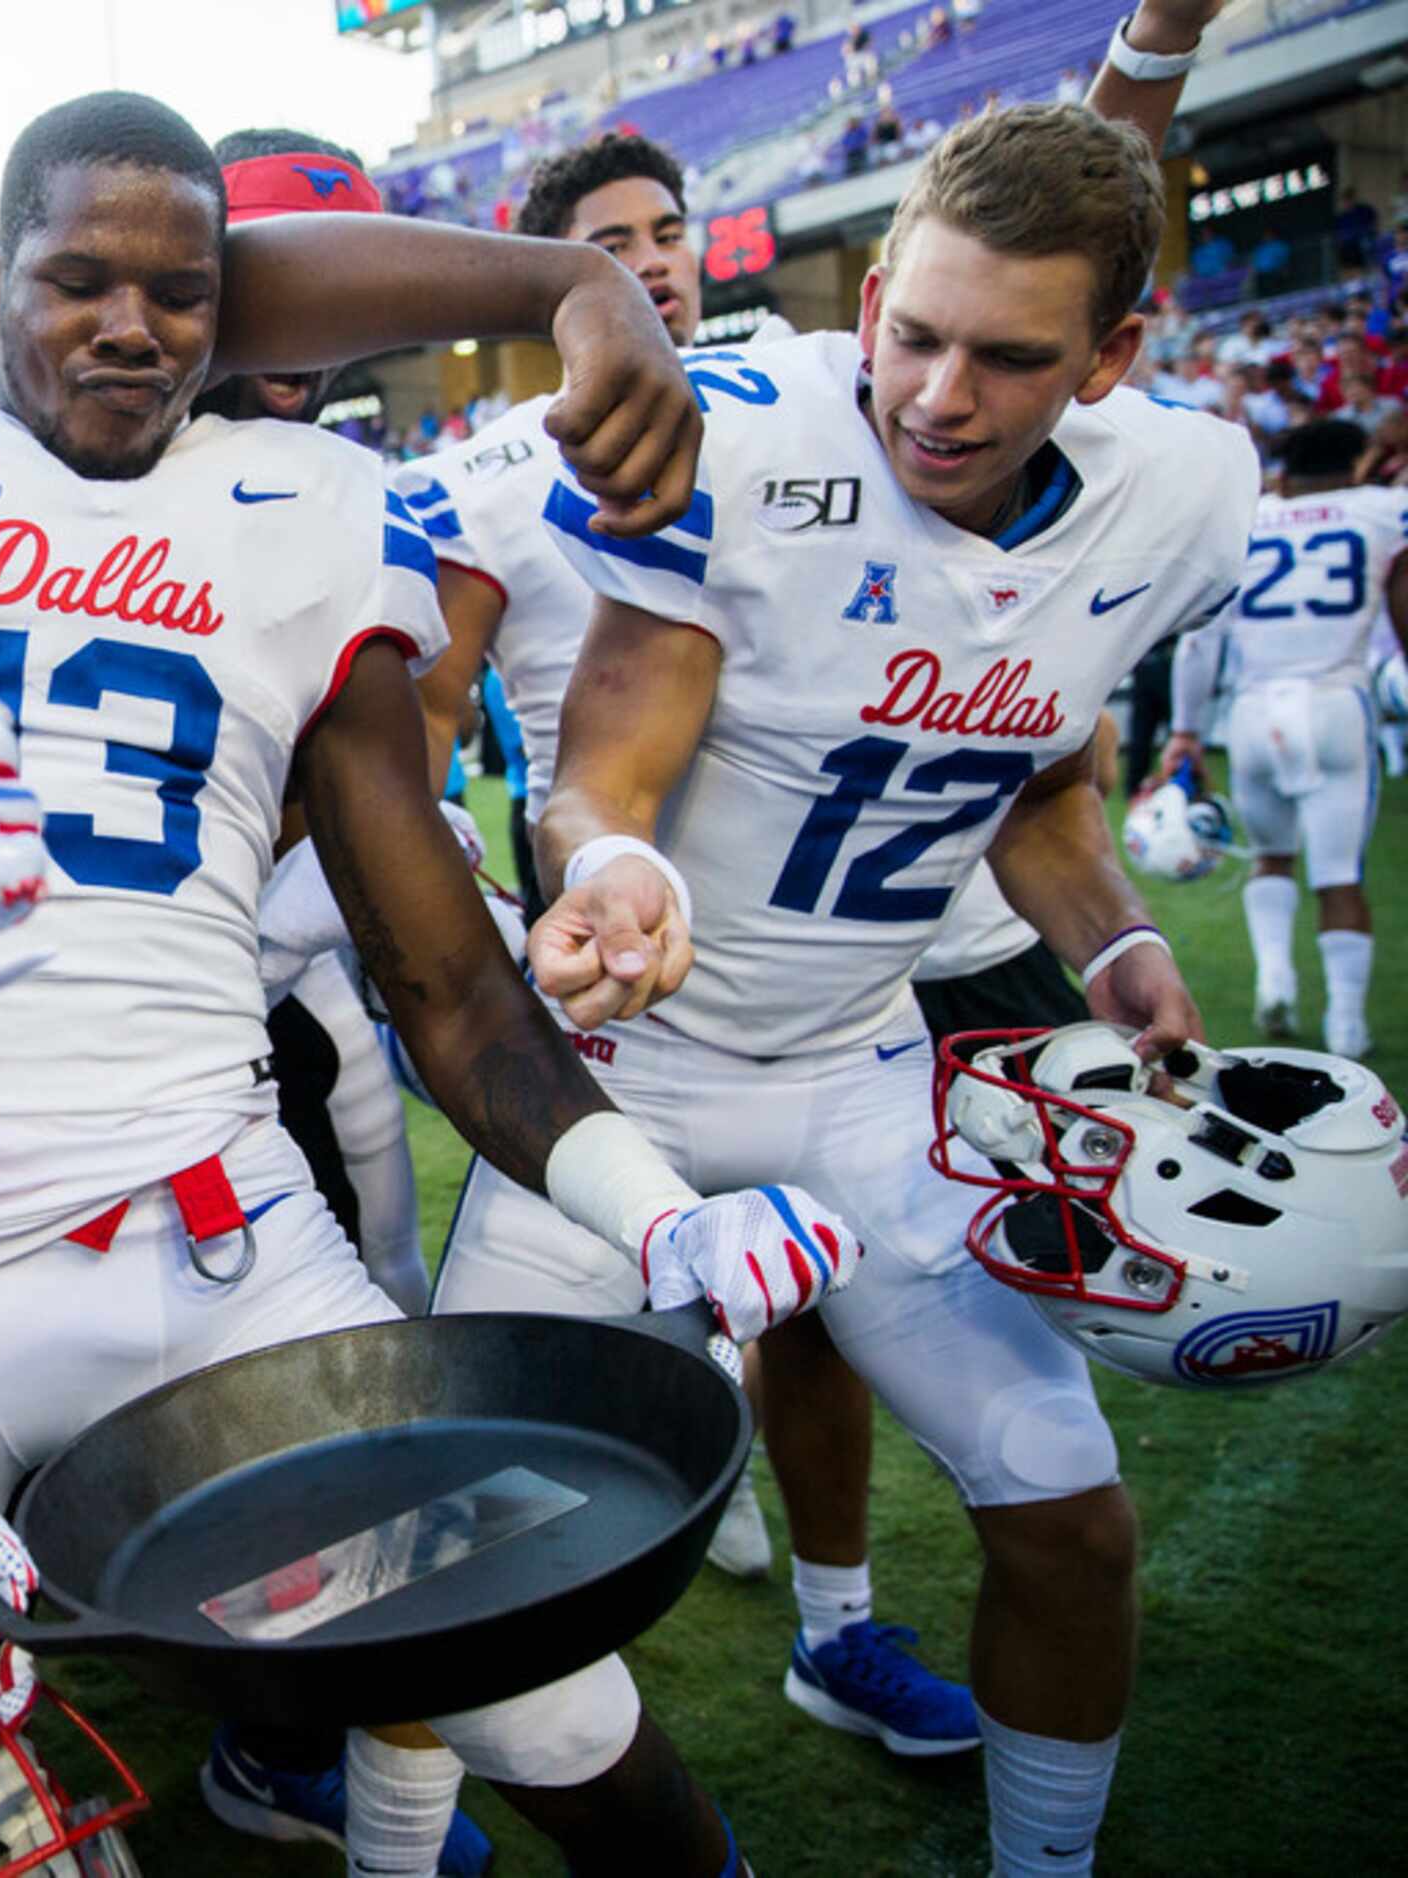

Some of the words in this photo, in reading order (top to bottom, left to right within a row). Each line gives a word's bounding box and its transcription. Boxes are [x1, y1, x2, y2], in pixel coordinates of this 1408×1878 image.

[1189, 163, 1331, 222] SEWELL
[705, 207, 776, 281] 25
[464, 439, 534, 478] 150
[762, 477, 862, 532] 150
[1241, 529, 1367, 619] 23
[860, 649, 1066, 738] Dallas
[768, 734, 1035, 923] 12
